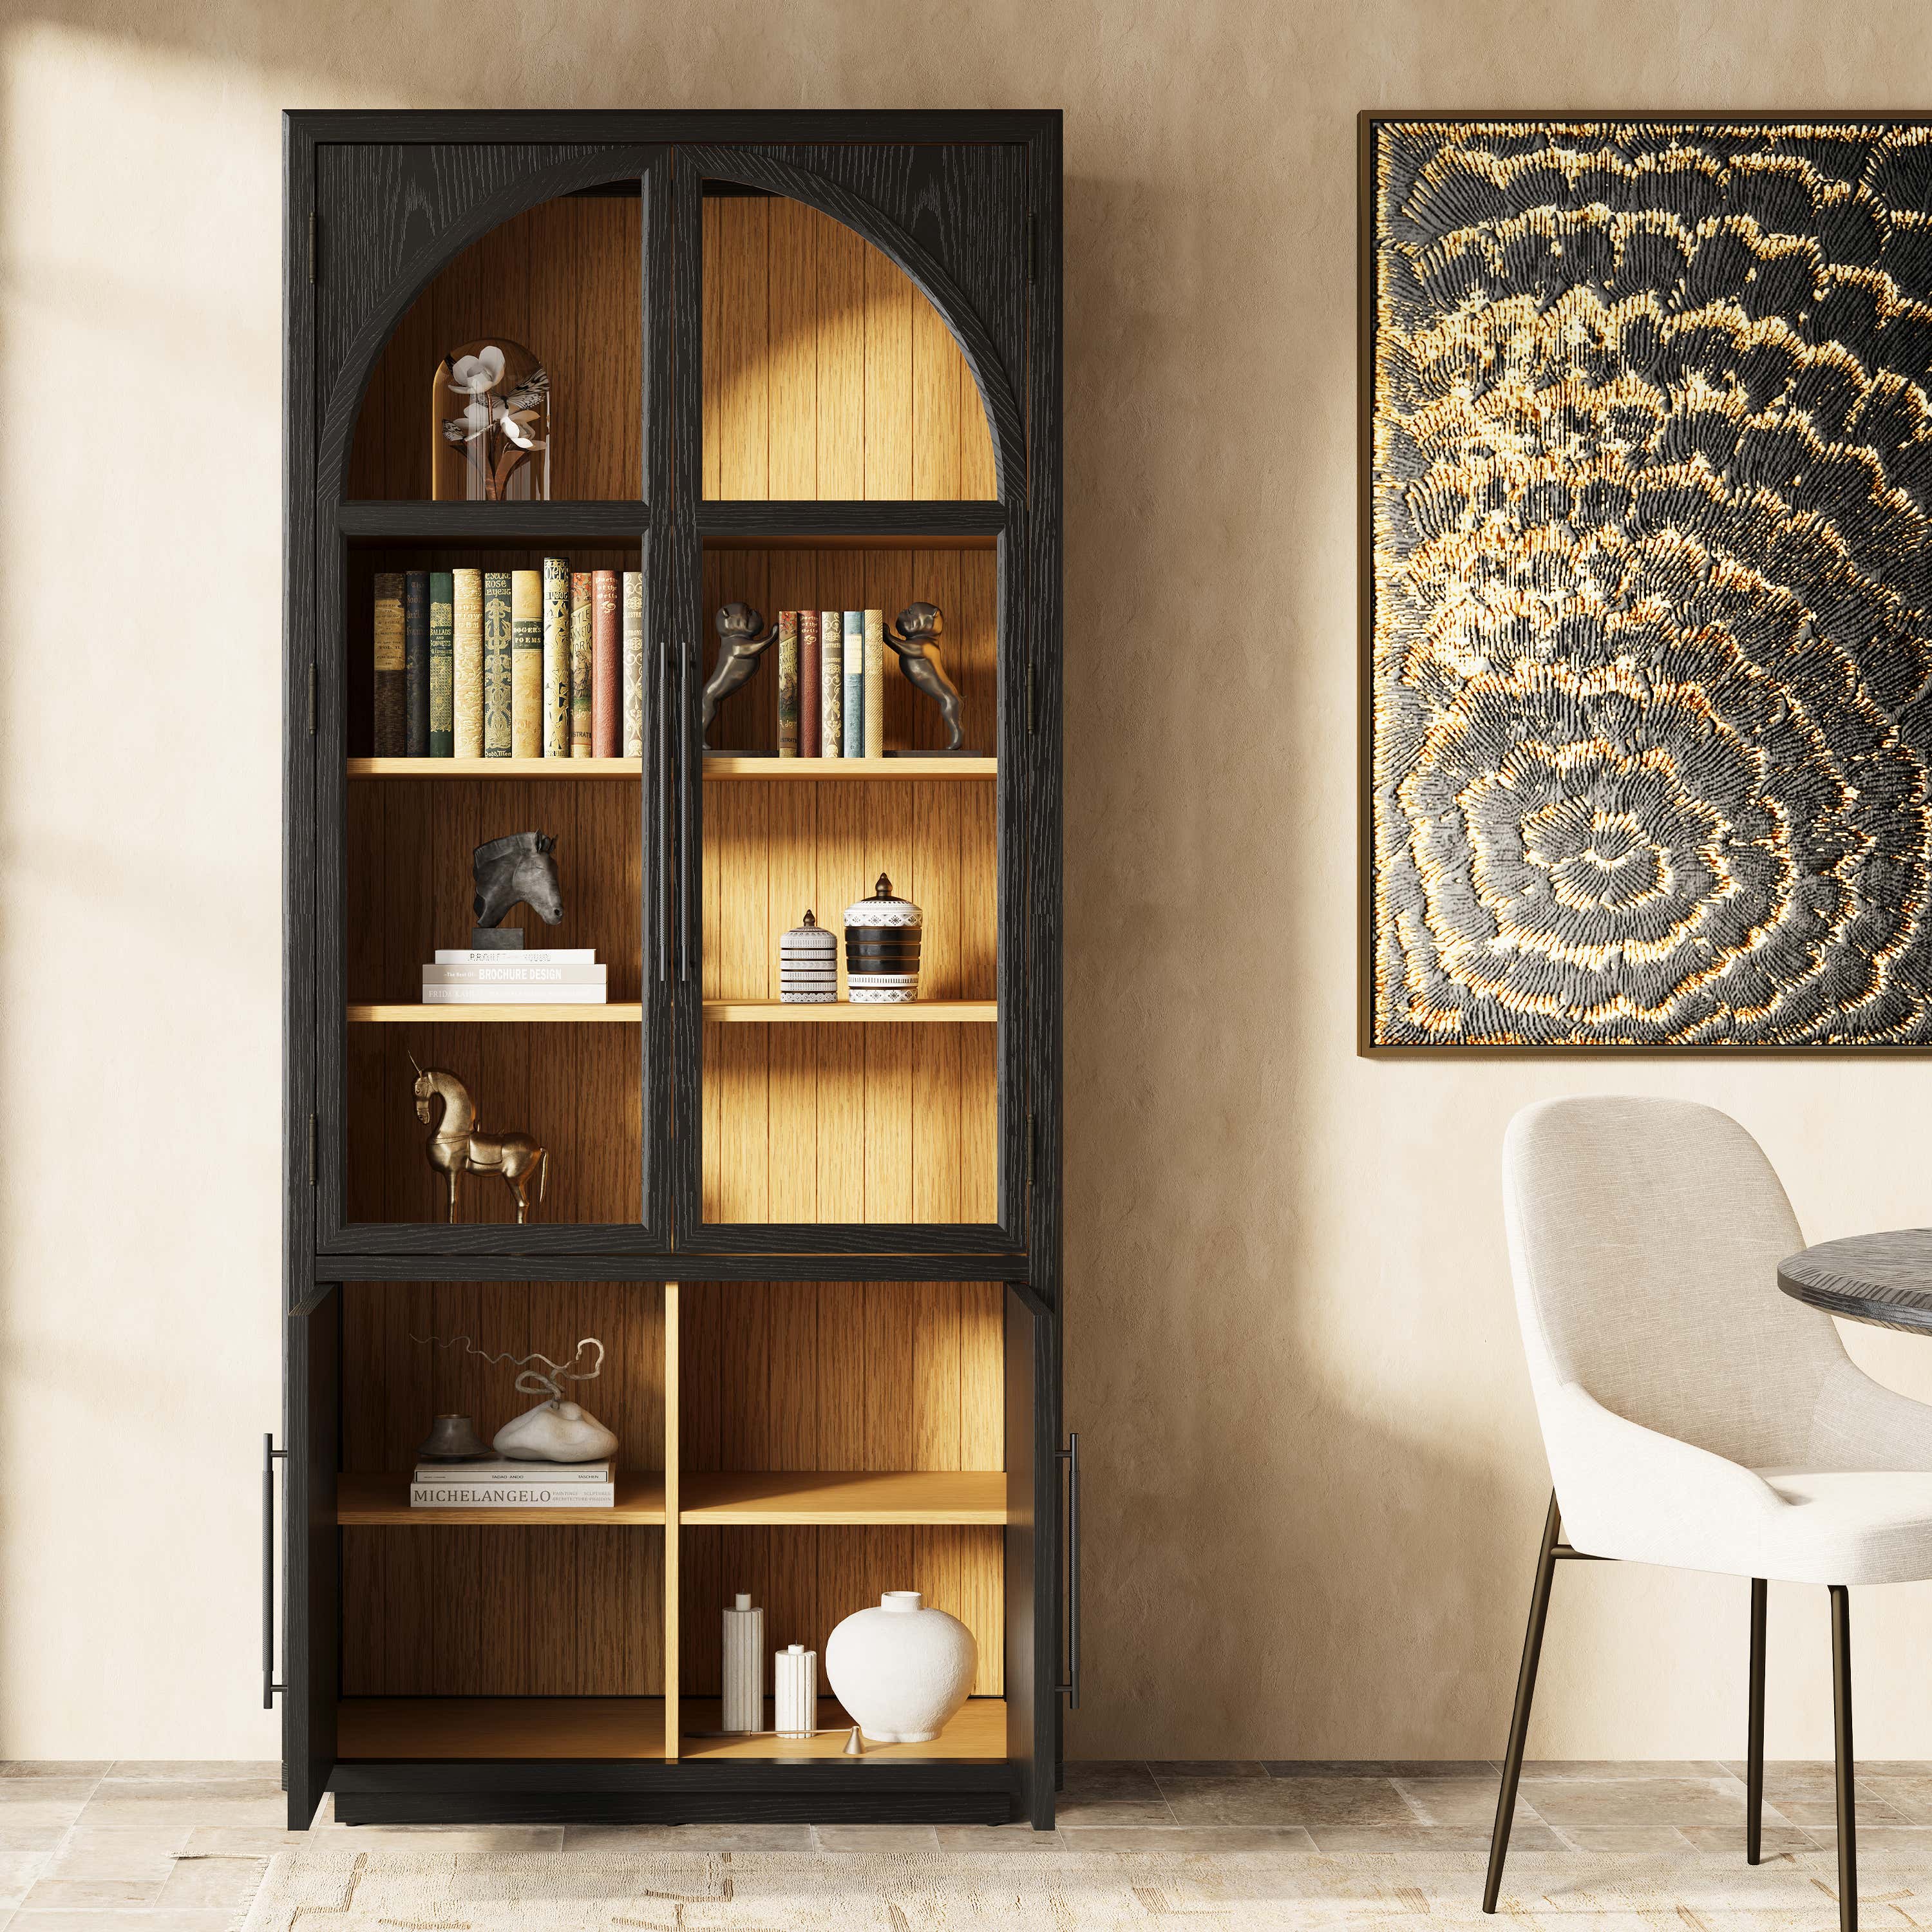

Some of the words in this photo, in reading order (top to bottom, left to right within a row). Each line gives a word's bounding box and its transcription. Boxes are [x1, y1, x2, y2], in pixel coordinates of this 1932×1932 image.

[478, 968, 527, 980] BROCHURE
[529, 968, 562, 980] DESIGN
[413, 1490, 551, 1502] MICHELANGELO
